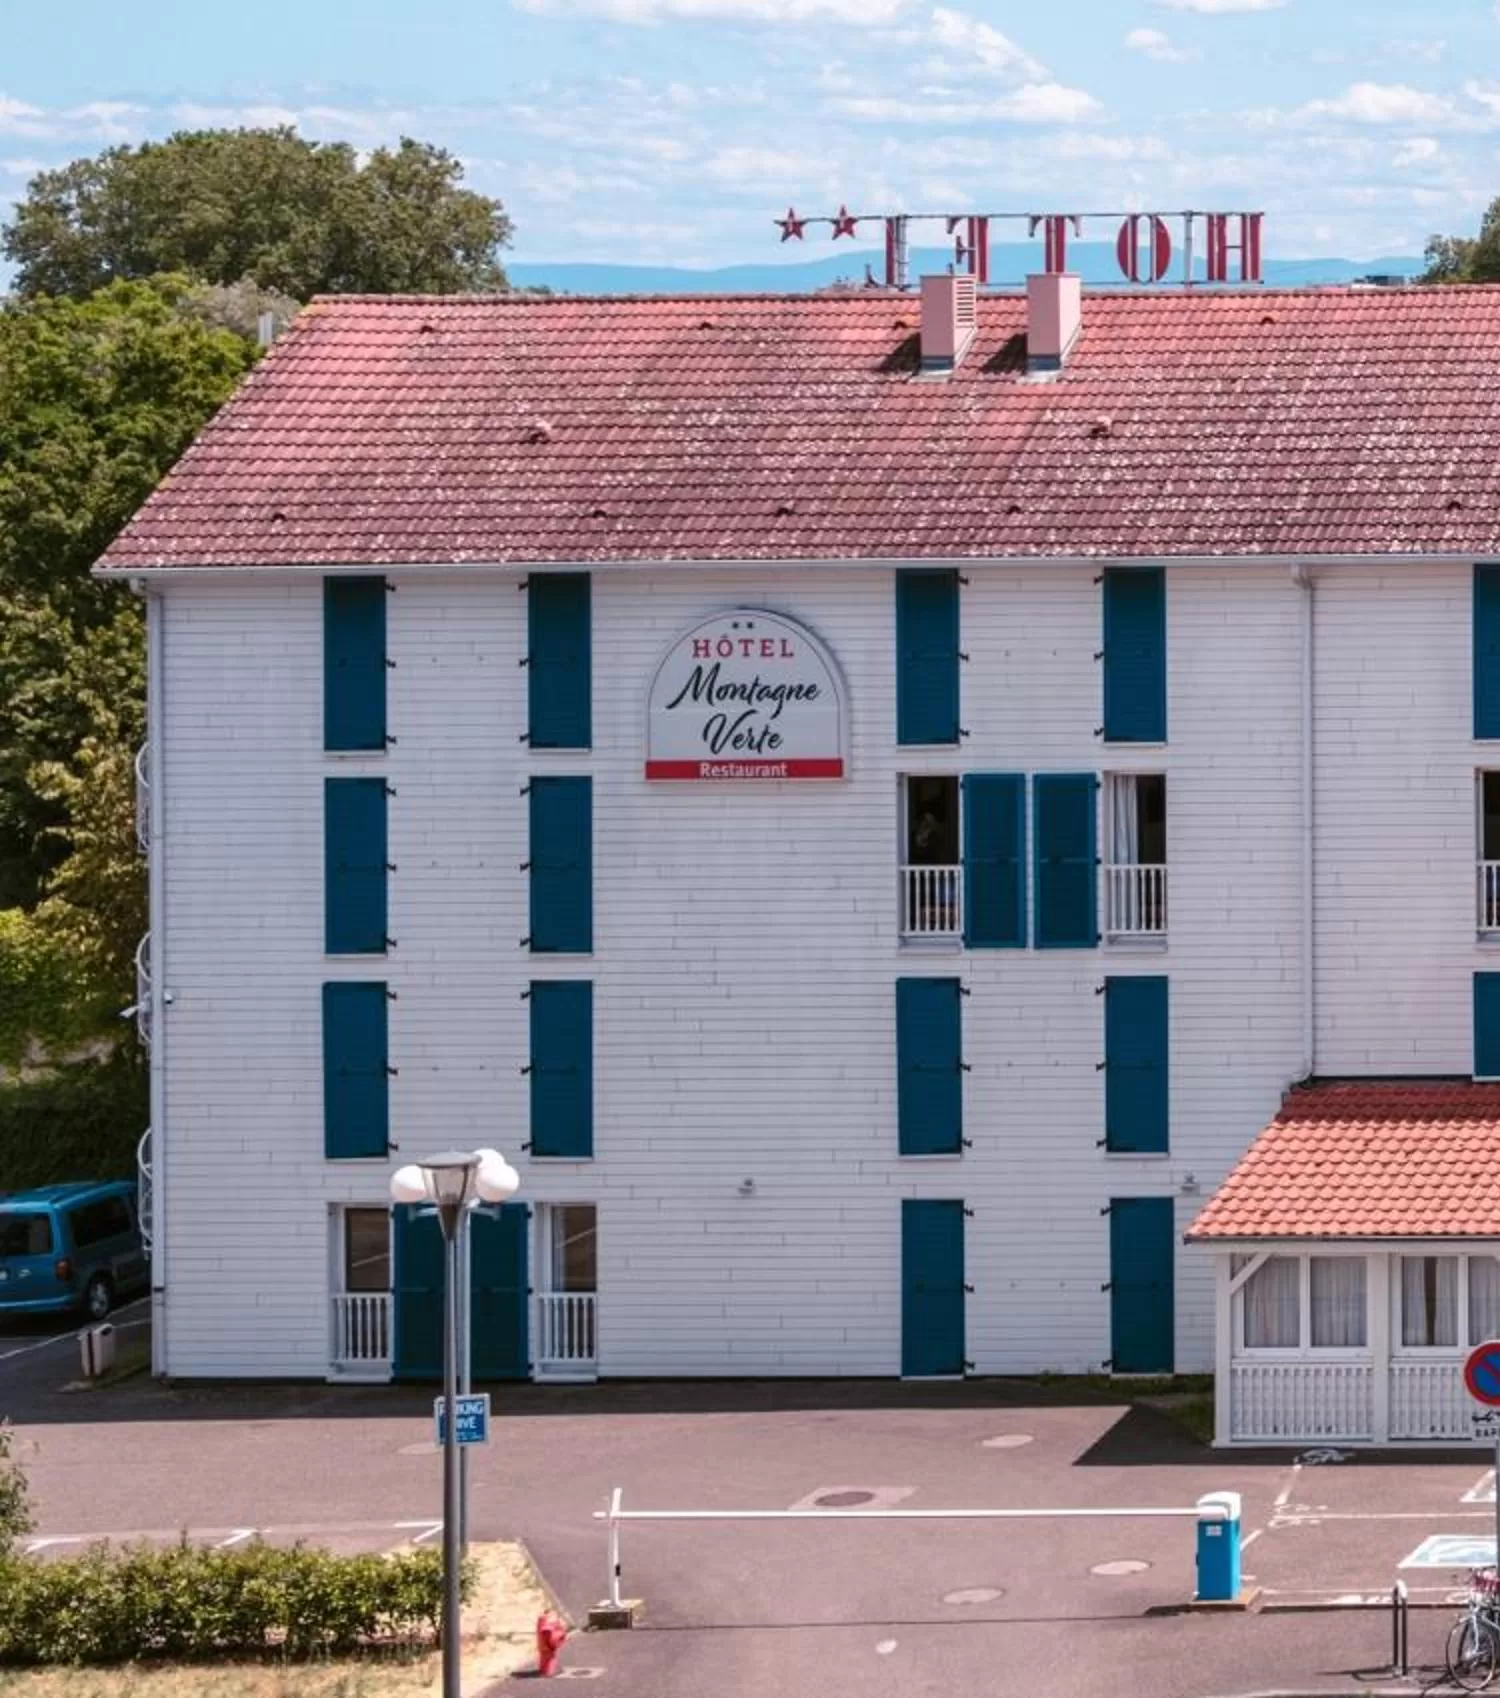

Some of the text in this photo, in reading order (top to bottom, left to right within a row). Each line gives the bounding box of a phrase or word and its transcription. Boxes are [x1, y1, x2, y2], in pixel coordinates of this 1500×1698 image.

[692, 633, 794, 659] HÔTEL
[666, 662, 821, 720] Montagne
[702, 709, 783, 755] Verte
[700, 762, 788, 778] Restaurant
